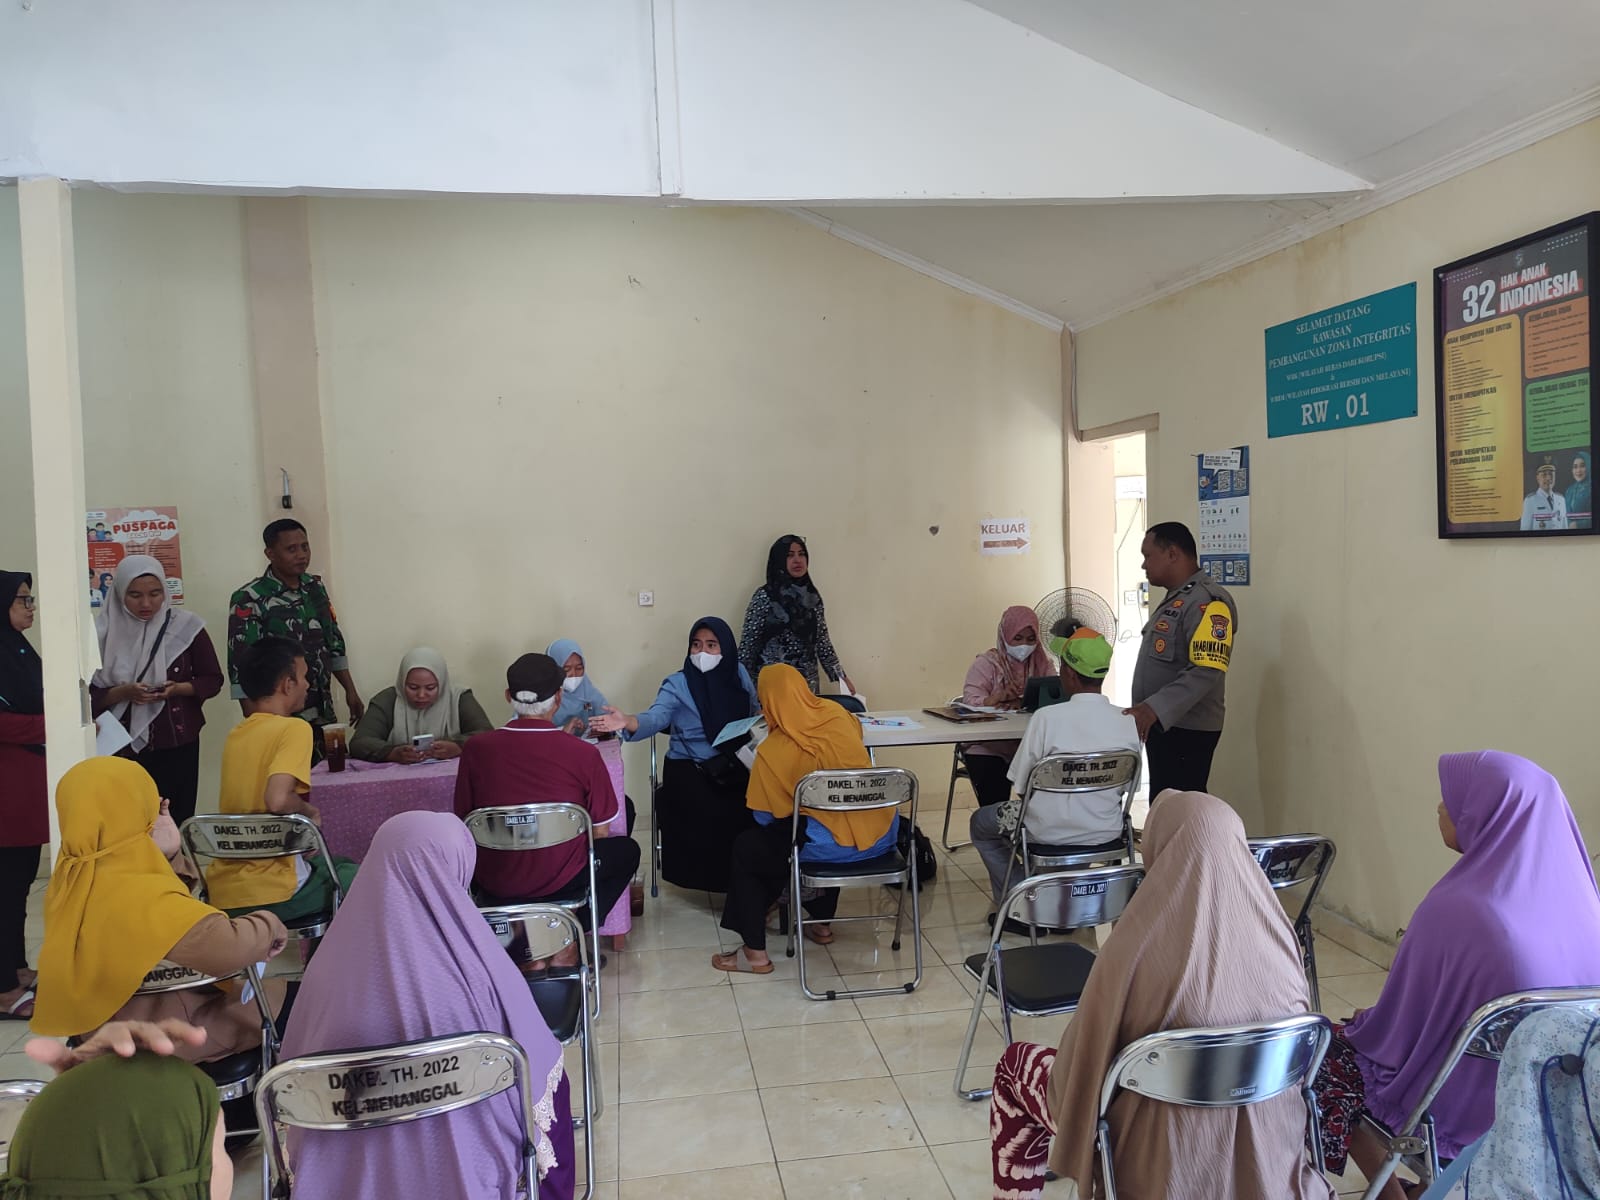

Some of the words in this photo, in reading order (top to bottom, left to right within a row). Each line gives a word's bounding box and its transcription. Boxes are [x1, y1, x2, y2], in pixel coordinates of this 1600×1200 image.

[1501, 272, 1518, 288] HAK
[1521, 263, 1546, 282] ANAK
[1462, 280, 1496, 323] 32
[1500, 270, 1578, 313] INDONESIA
[1296, 314, 1331, 335] SELAMAT
[1334, 304, 1371, 323] DATANG
[1313, 324, 1352, 344] KAWASAN
[1269, 346, 1326, 369] PEMBANGUNAN
[1328, 339, 1351, 354] ZONA
[1352, 323, 1411, 348] INTEGRITAS
[1301, 400, 1329, 426] RW
[1346, 392, 1369, 418] 01
[112, 521, 177, 534] PUSPAGA
[981, 523, 1025, 534] KELUAR
[1063, 762, 1088, 772] DAKEL
[828, 780, 854, 789] DAKEL
[870, 778, 887, 788] 2022
[1061, 777, 1075, 785] KEL
[828, 795, 842, 803] KEL
[843, 792, 887, 803] MENANGGAL
[213, 825, 243, 836] DAKEL
[261, 824, 282, 833] 2022
[234, 838, 285, 850] MENANGGAL
[328, 1070, 388, 1091] DAKEL
[391, 1066, 418, 1083] TH.
[423, 1055, 460, 1078] 2022
[366, 1081, 463, 1114] MENANGGAL
